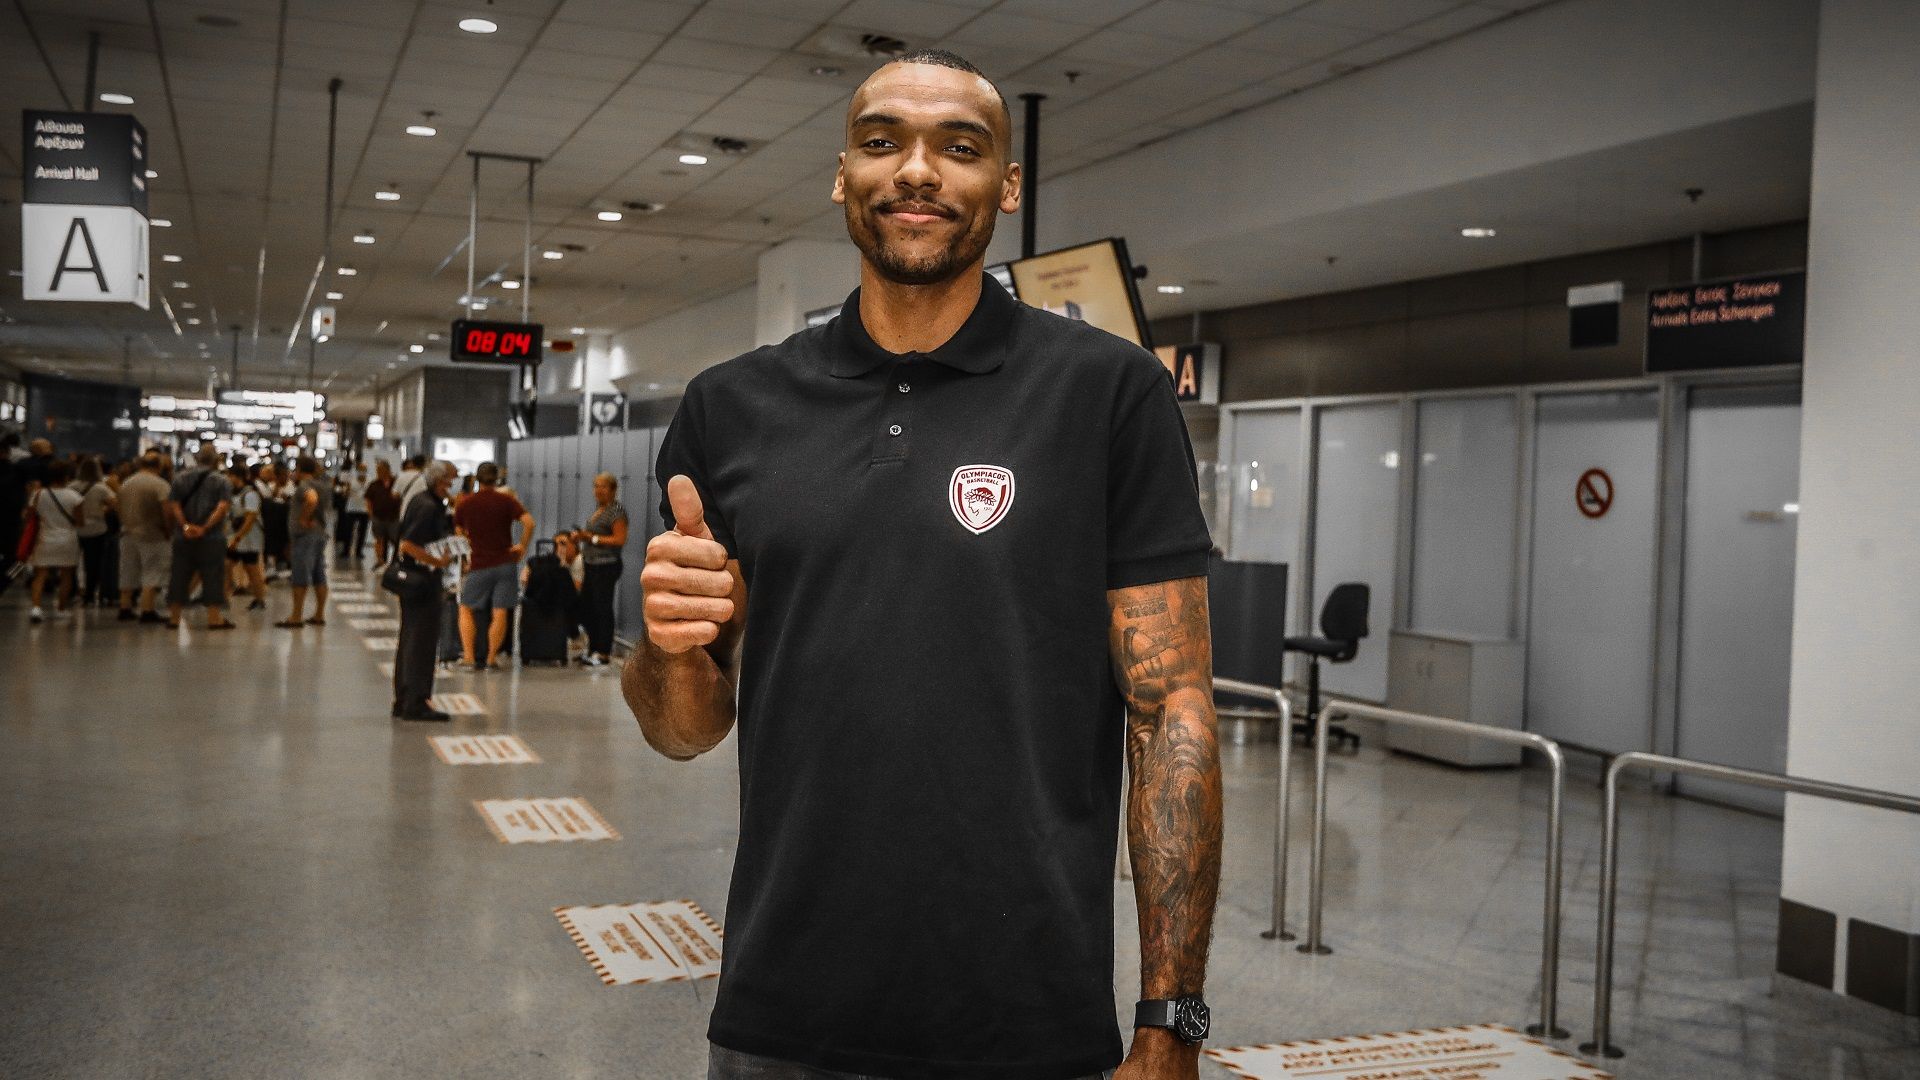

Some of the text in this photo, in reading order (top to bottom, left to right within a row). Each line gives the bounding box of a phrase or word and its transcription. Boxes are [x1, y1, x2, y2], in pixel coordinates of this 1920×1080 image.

[34, 164, 99, 181] Arrival Hall
[49, 217, 109, 292] A
[1177, 353, 1198, 397] A
[961, 471, 1006, 481] OLYMPIACOS
